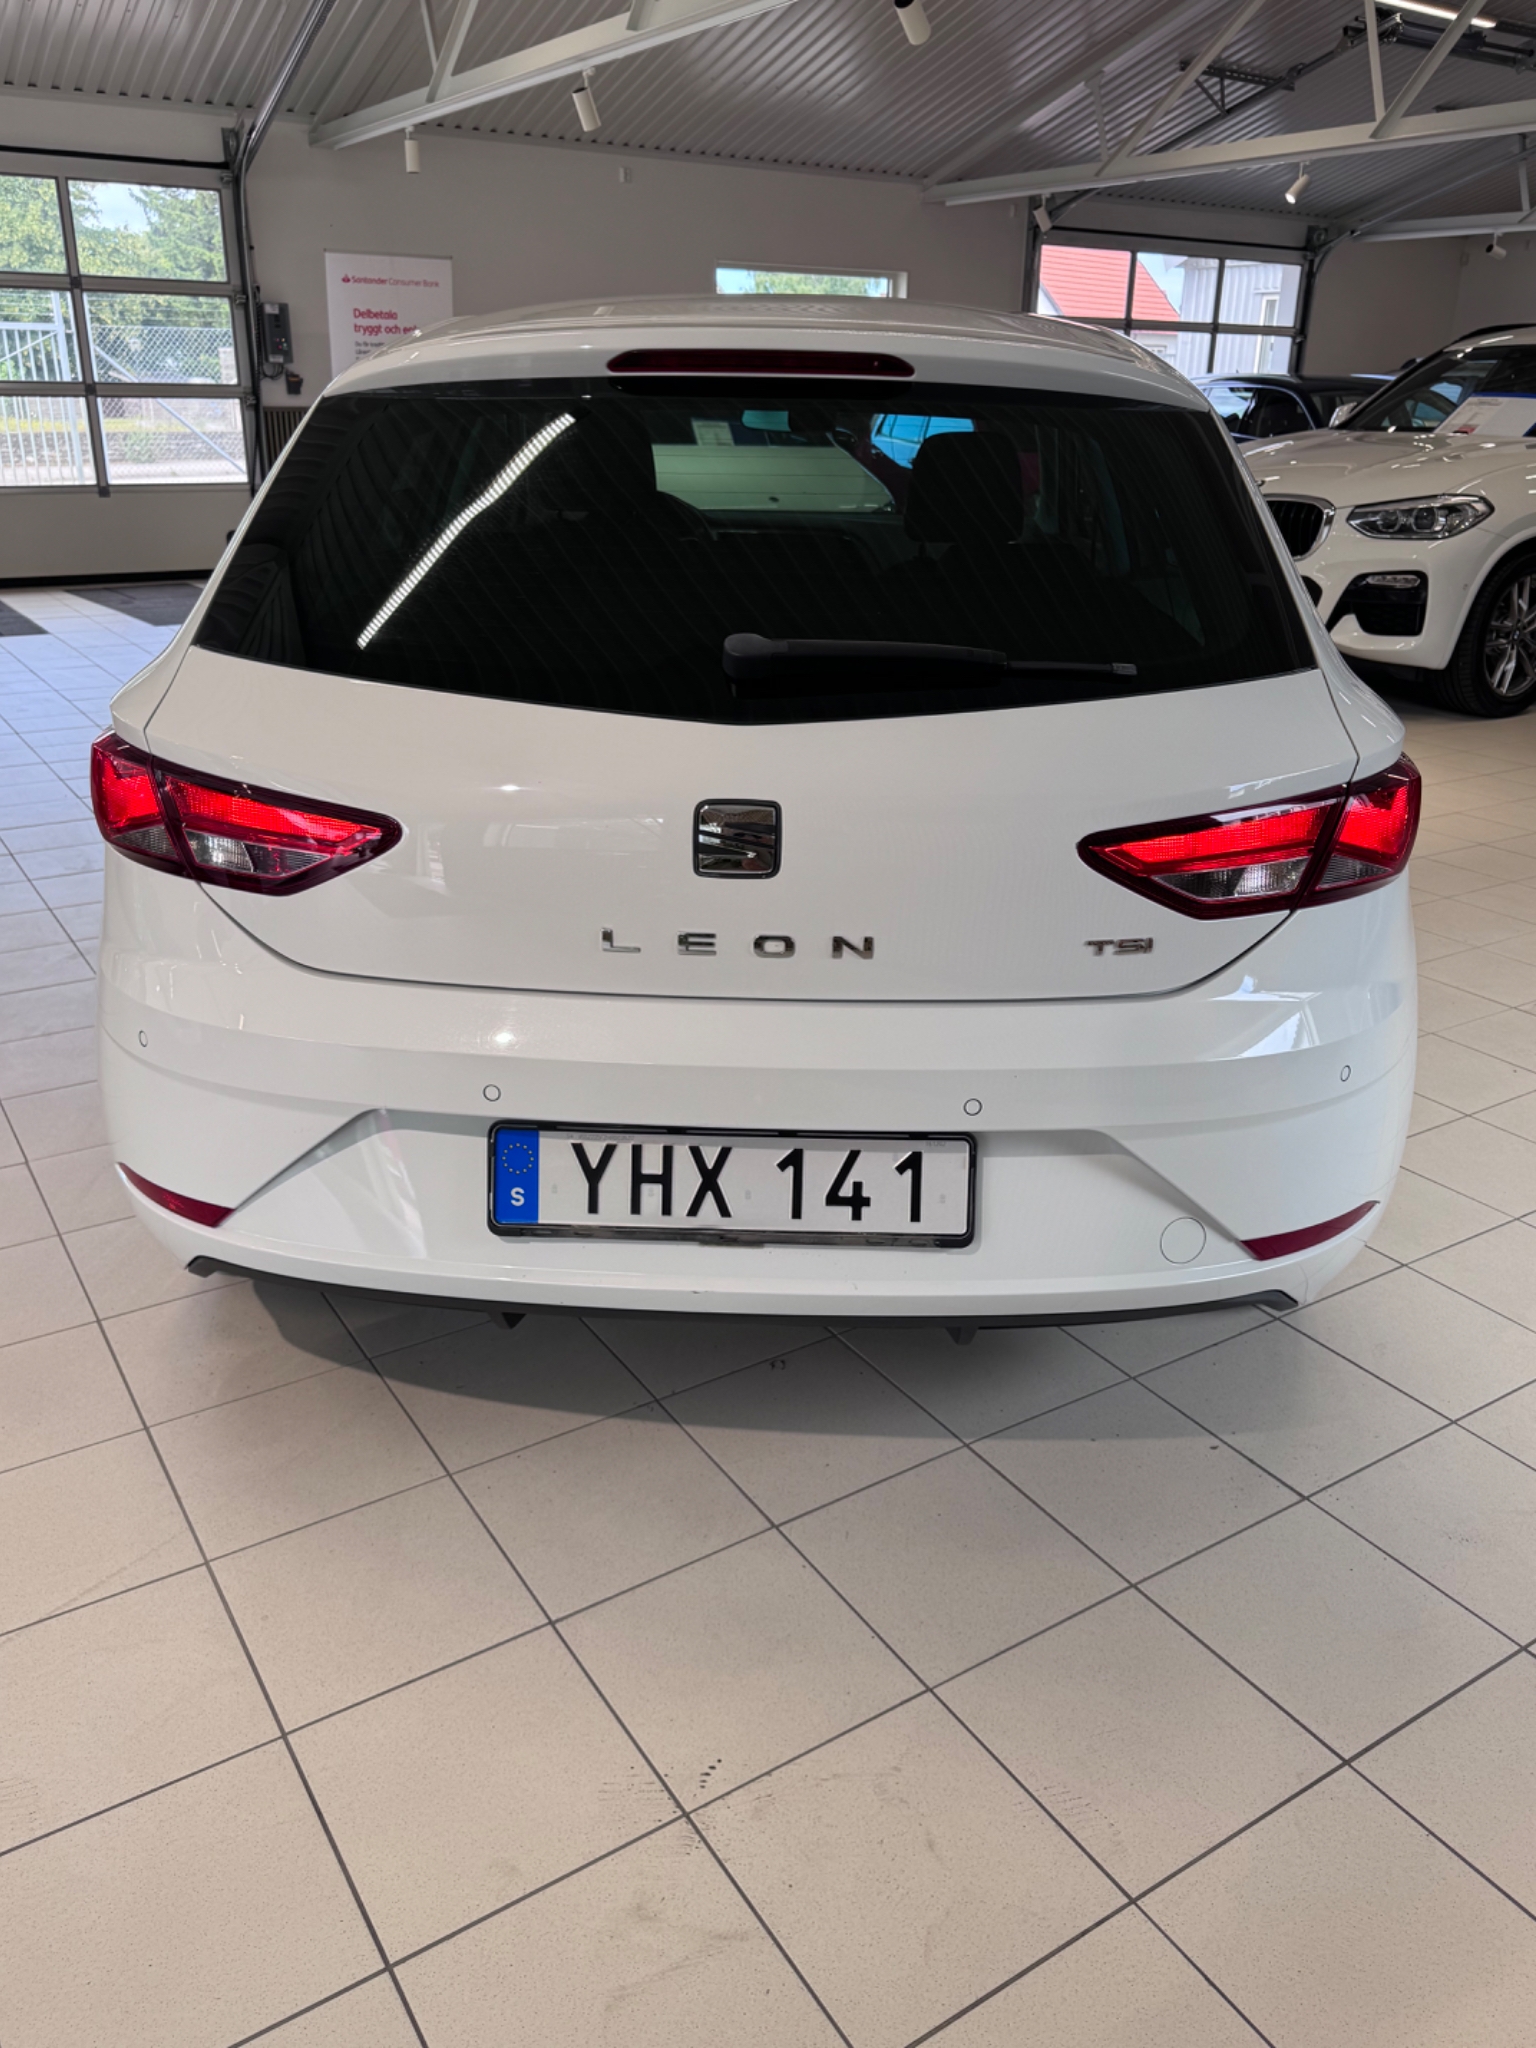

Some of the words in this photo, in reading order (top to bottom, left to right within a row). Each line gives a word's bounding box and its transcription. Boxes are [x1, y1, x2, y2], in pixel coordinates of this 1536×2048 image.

[352, 276, 387, 285] Santander
[388, 278, 422, 287] Consumer
[353, 308, 398, 320] Delbetala
[354, 324, 382, 336] tryggt
[384, 325, 400, 334] och
[601, 927, 874, 960] LEON
[1083, 937, 1153, 957] TSI
[570, 1142, 733, 1218] YHX
[776, 1148, 923, 1222] 141
[510, 1186, 525, 1206] S
